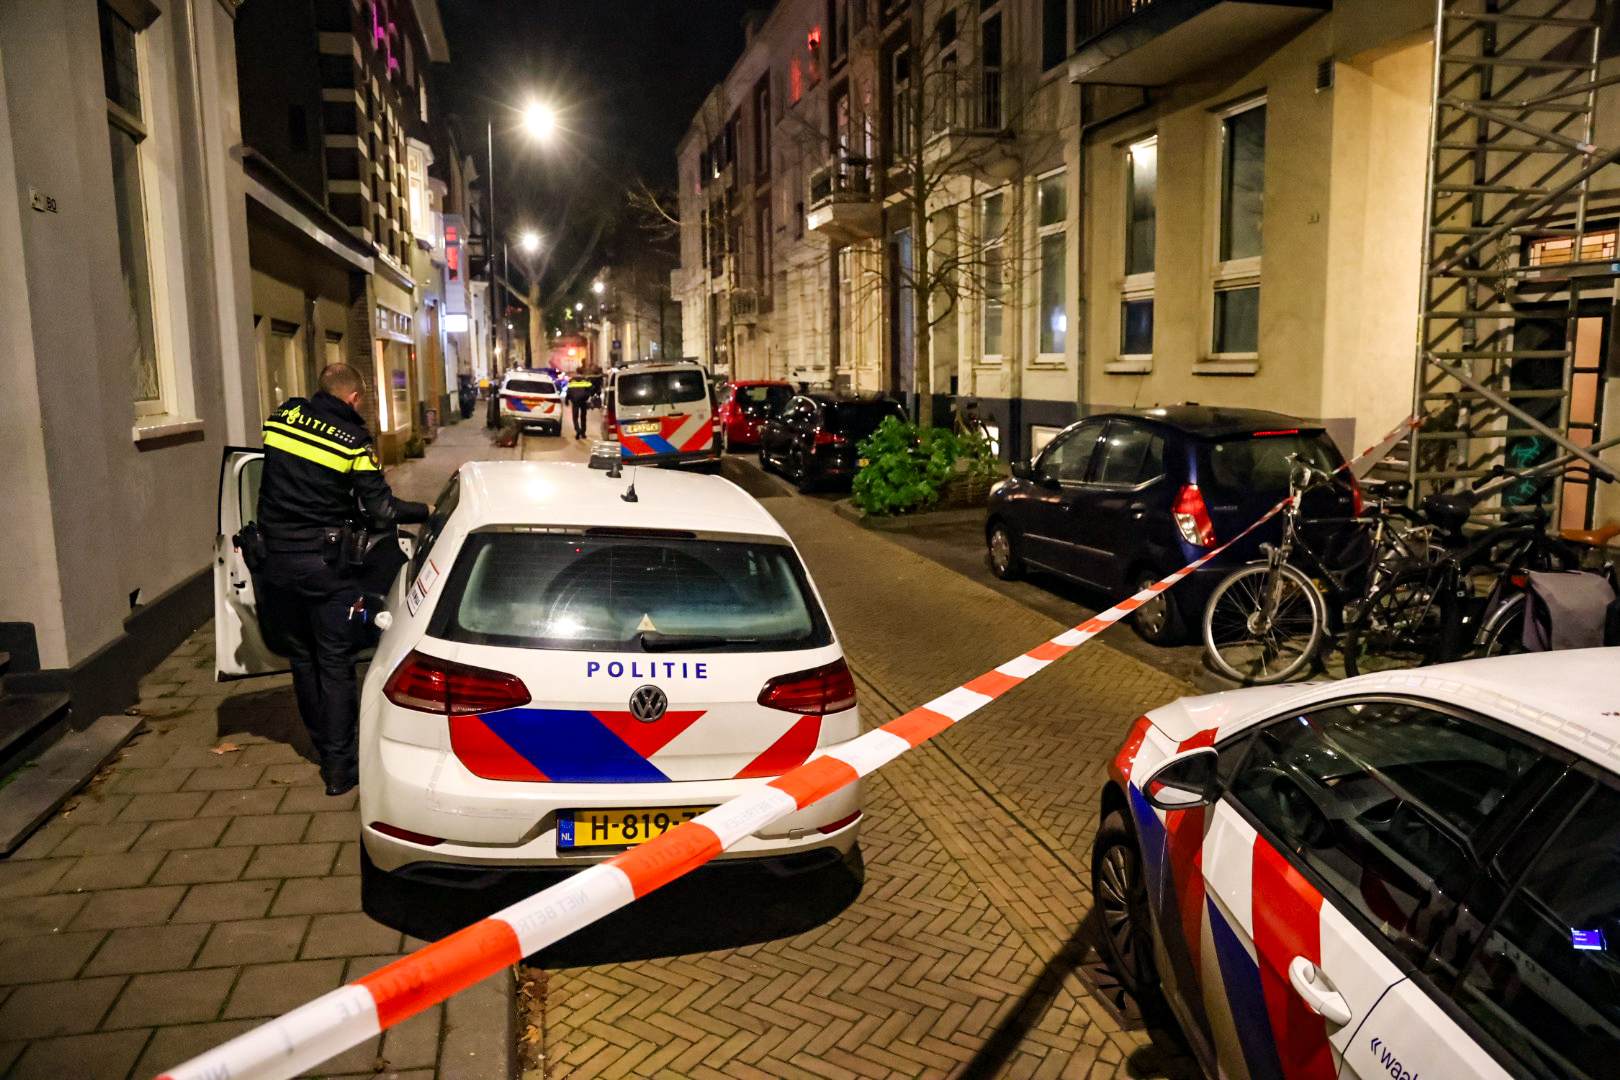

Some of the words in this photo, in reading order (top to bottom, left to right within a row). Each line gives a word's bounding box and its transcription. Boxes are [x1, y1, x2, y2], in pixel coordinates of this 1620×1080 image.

[281, 405, 337, 436] POLITIE
[587, 661, 708, 680] POLITIE
[561, 833, 574, 842] NL
[591, 811, 704, 841] H-819-
